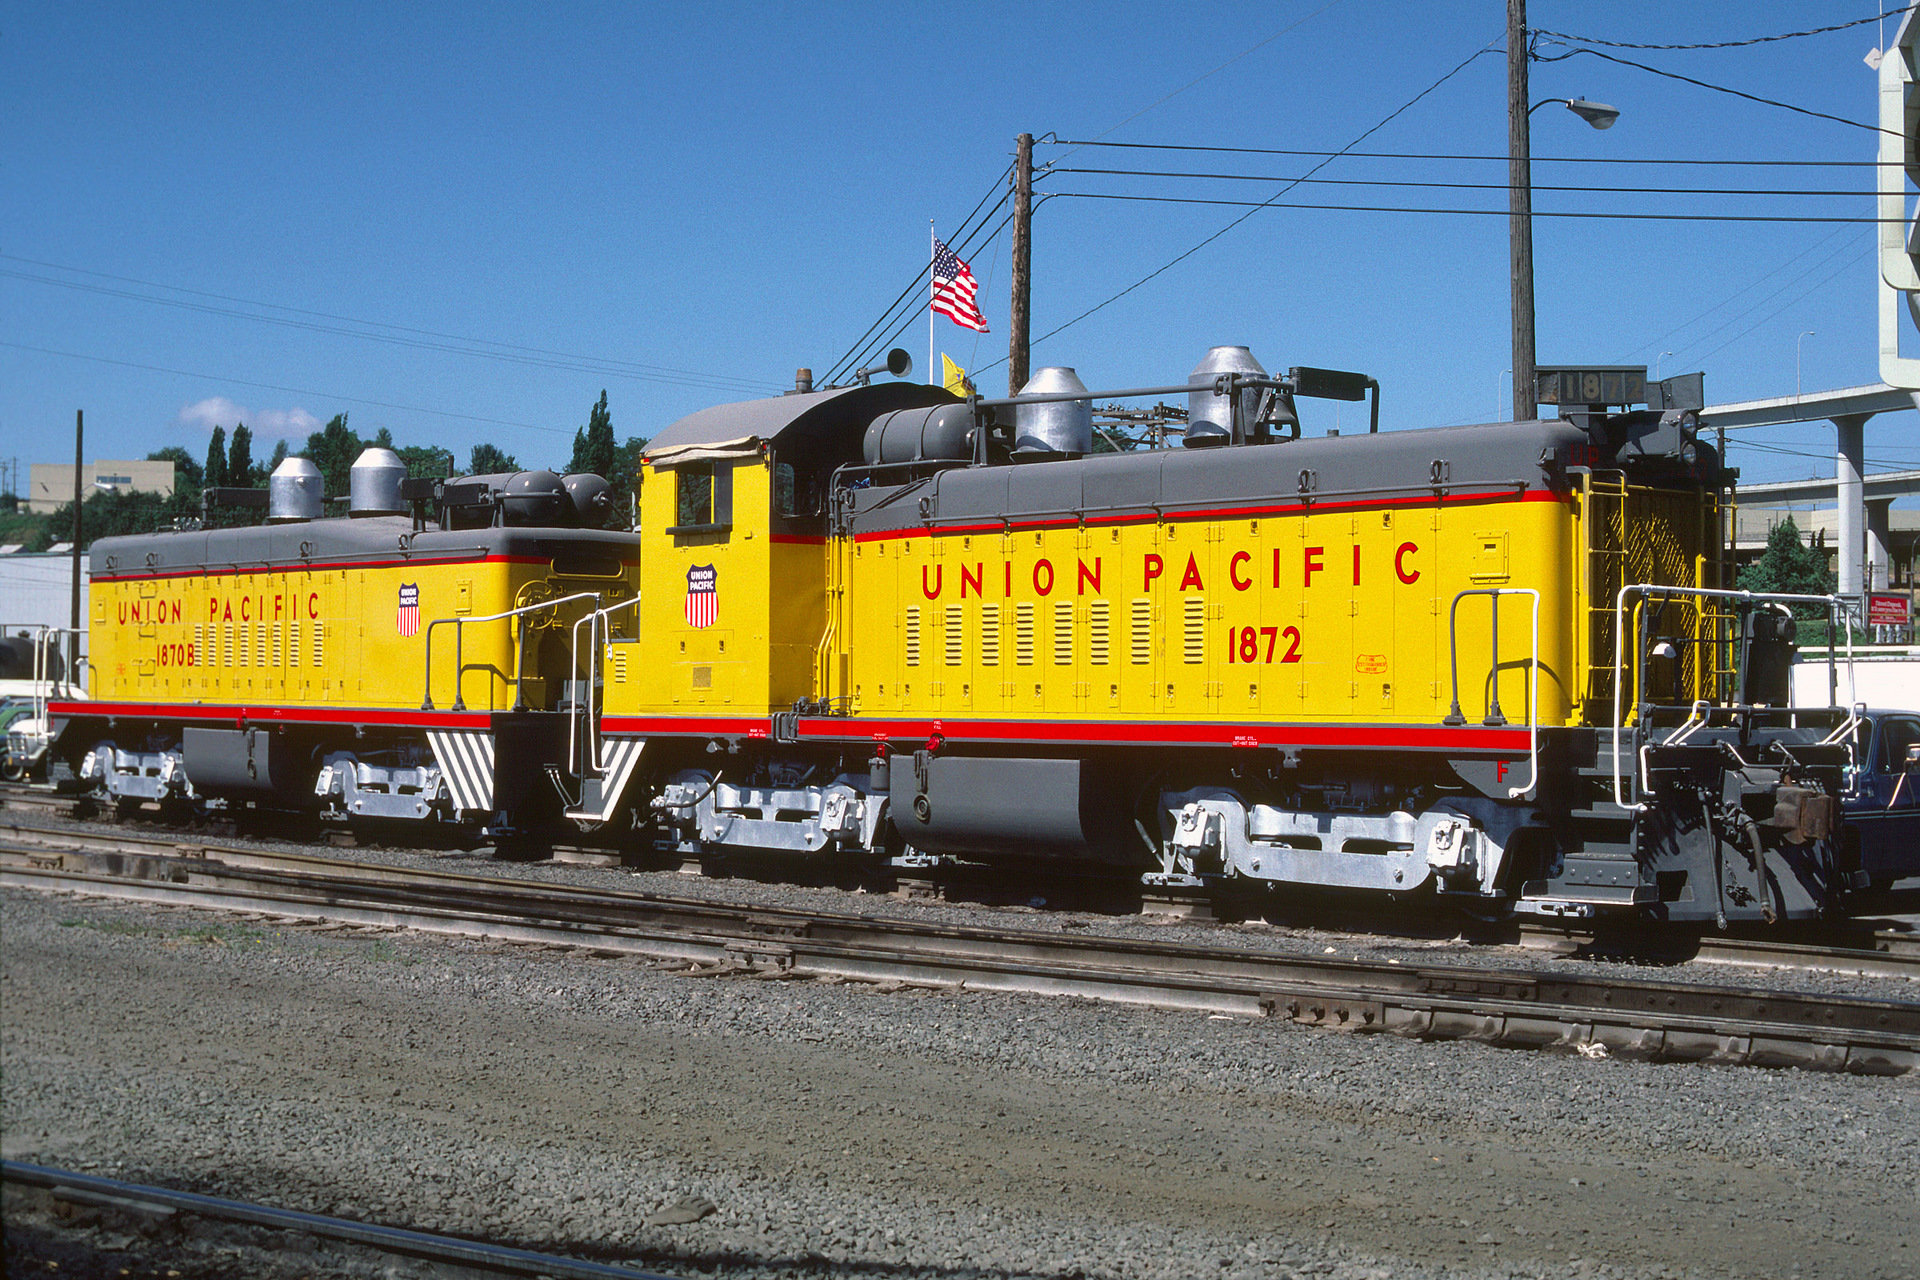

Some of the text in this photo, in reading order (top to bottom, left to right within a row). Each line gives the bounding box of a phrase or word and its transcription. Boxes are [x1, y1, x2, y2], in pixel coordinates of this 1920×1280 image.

[1566, 373, 1642, 400] 1872
[690, 570, 713, 580] UNION
[922, 541, 1421, 600] UNION PACIFIC
[690, 580, 714, 591] PACIFIC
[118, 592, 319, 625] UNION PACIFIC
[156, 643, 194, 667] 1870B
[1229, 625, 1303, 664] 1872
[1497, 760, 1510, 783] F
